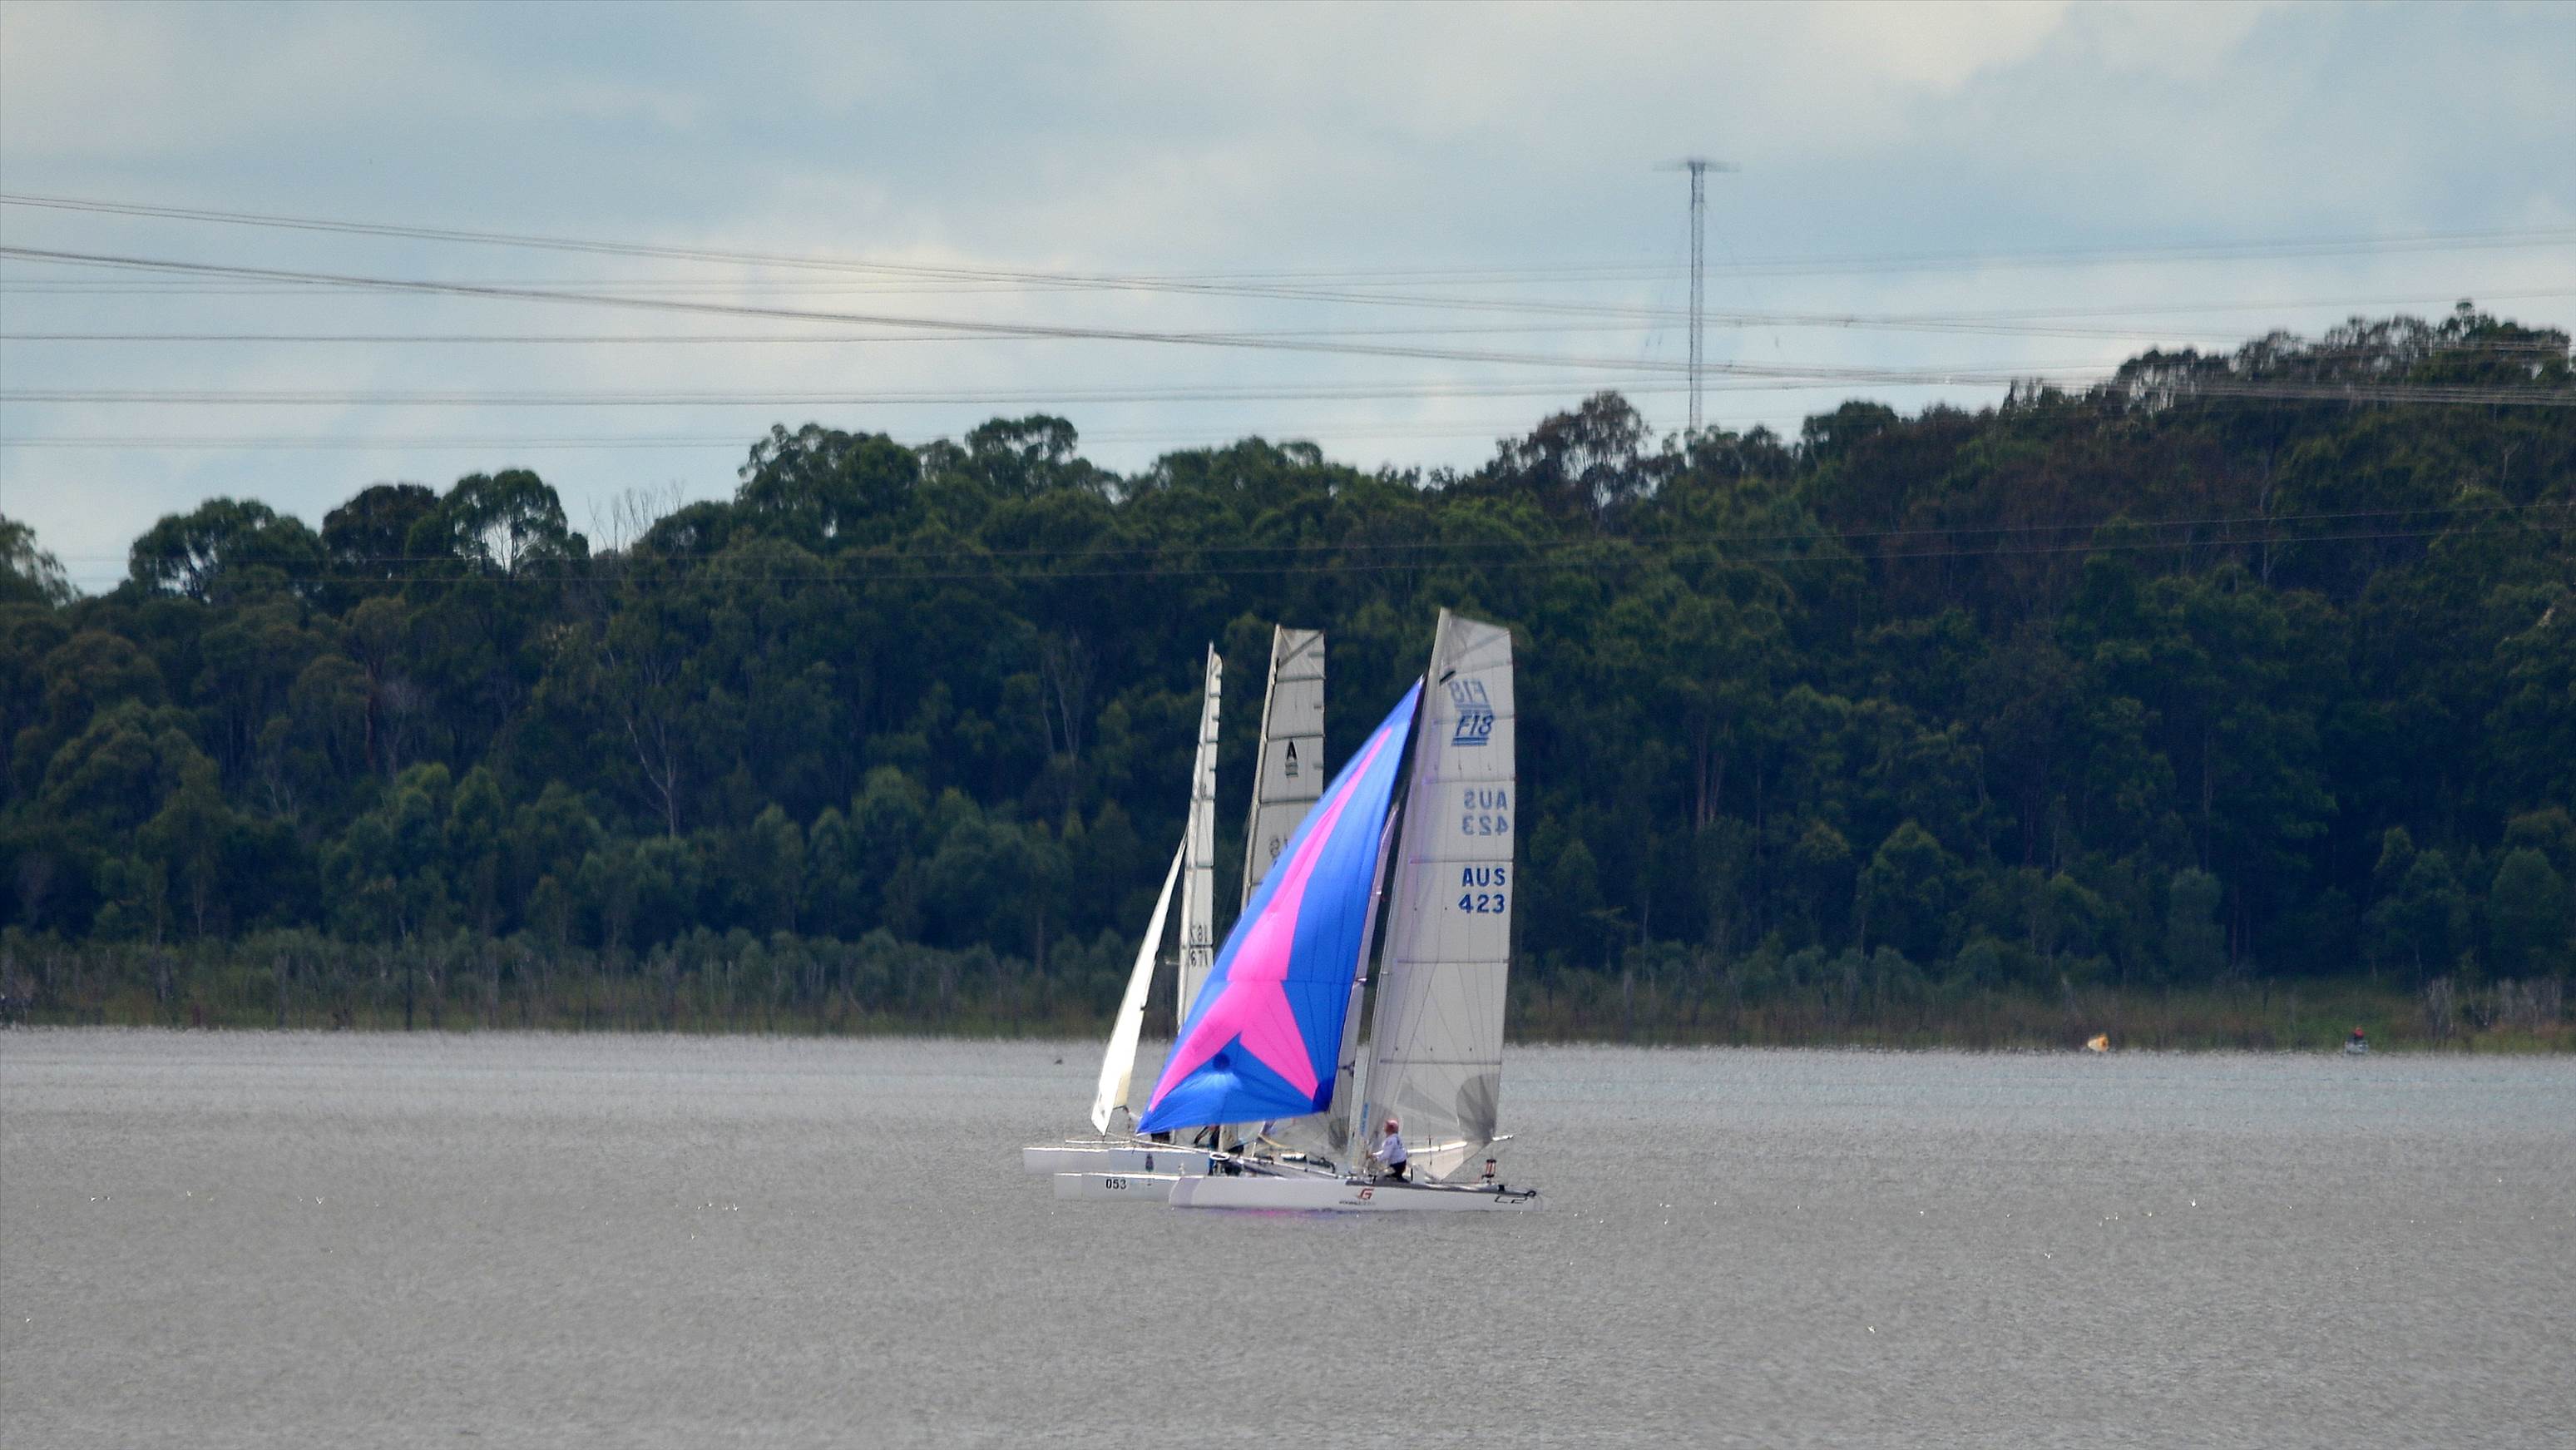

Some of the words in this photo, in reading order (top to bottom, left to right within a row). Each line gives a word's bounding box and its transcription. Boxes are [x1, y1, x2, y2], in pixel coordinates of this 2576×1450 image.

[1456, 714, 1494, 736] F18
[1462, 868, 1506, 887] AUS
[1458, 893, 1505, 913] 423
[1105, 1179, 1126, 1190] 053
